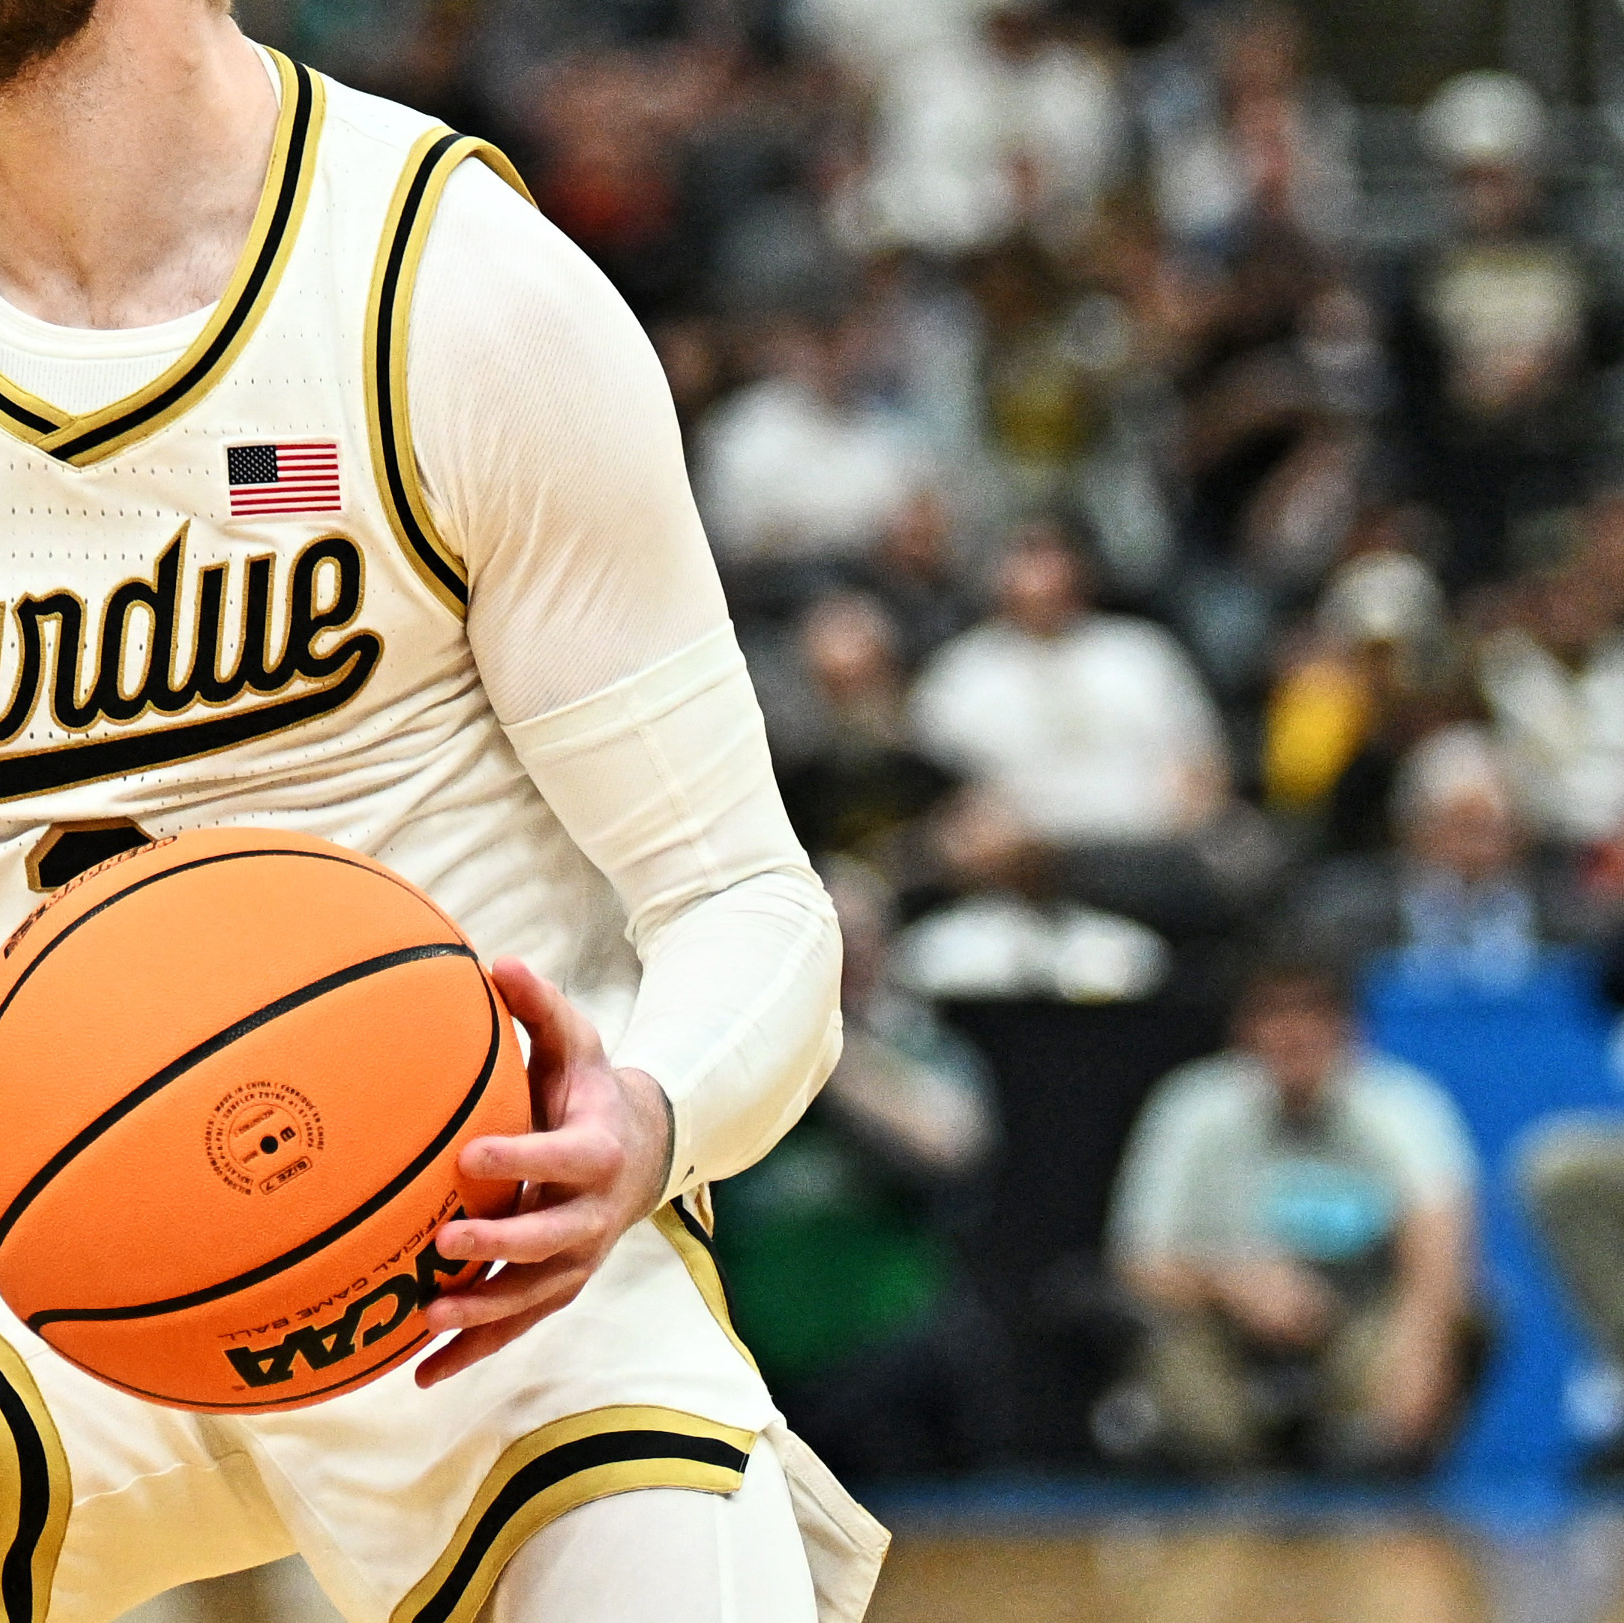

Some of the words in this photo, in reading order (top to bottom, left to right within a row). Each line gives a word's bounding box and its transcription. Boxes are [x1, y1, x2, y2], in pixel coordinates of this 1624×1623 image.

[276, 1160, 308, 1184] SIZE
[265, 1181, 275, 1192] 7
[372, 1189, 458, 1273] OFFICIAL
[296, 1277, 368, 1321] GAME
[217, 1317, 290, 1341] BALL
